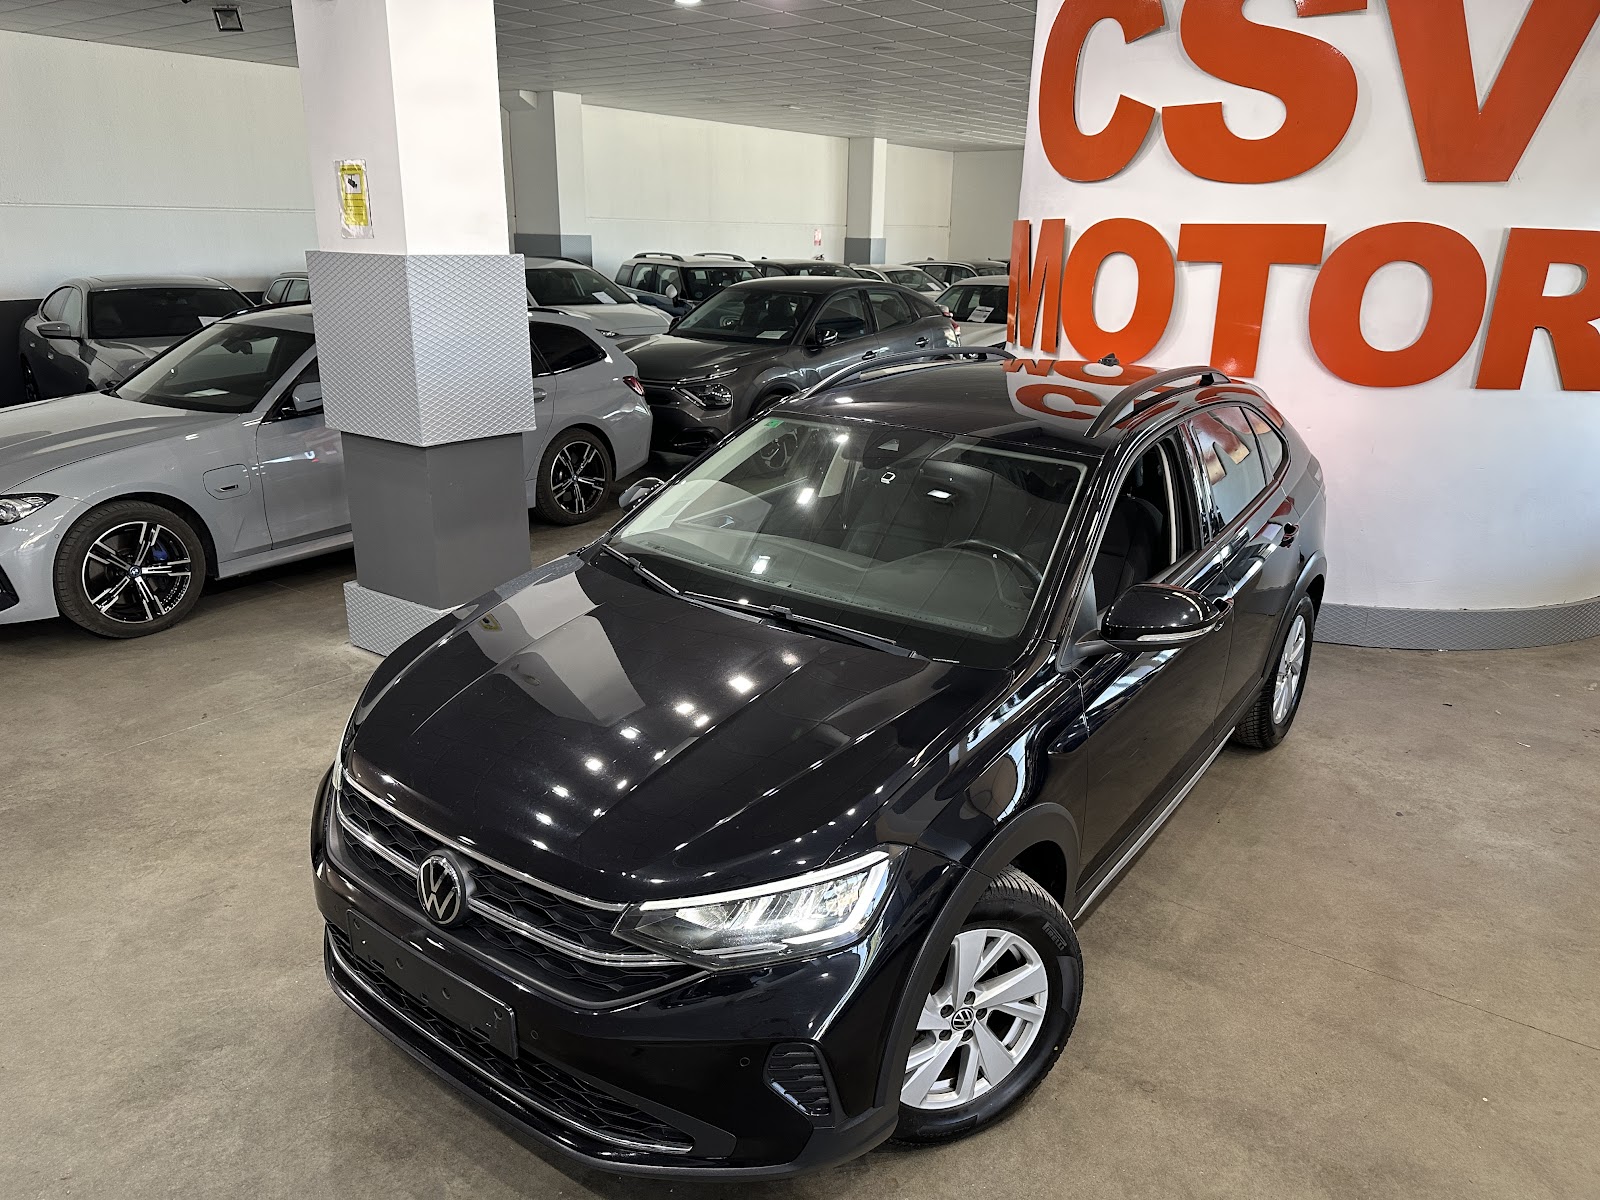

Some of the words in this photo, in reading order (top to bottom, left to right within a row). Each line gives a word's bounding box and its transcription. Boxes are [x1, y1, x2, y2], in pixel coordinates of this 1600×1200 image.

[1039, 0, 1600, 183] CSV
[418, 856, 461, 925] VW
[1041, 921, 1068, 951] PIRELLI
